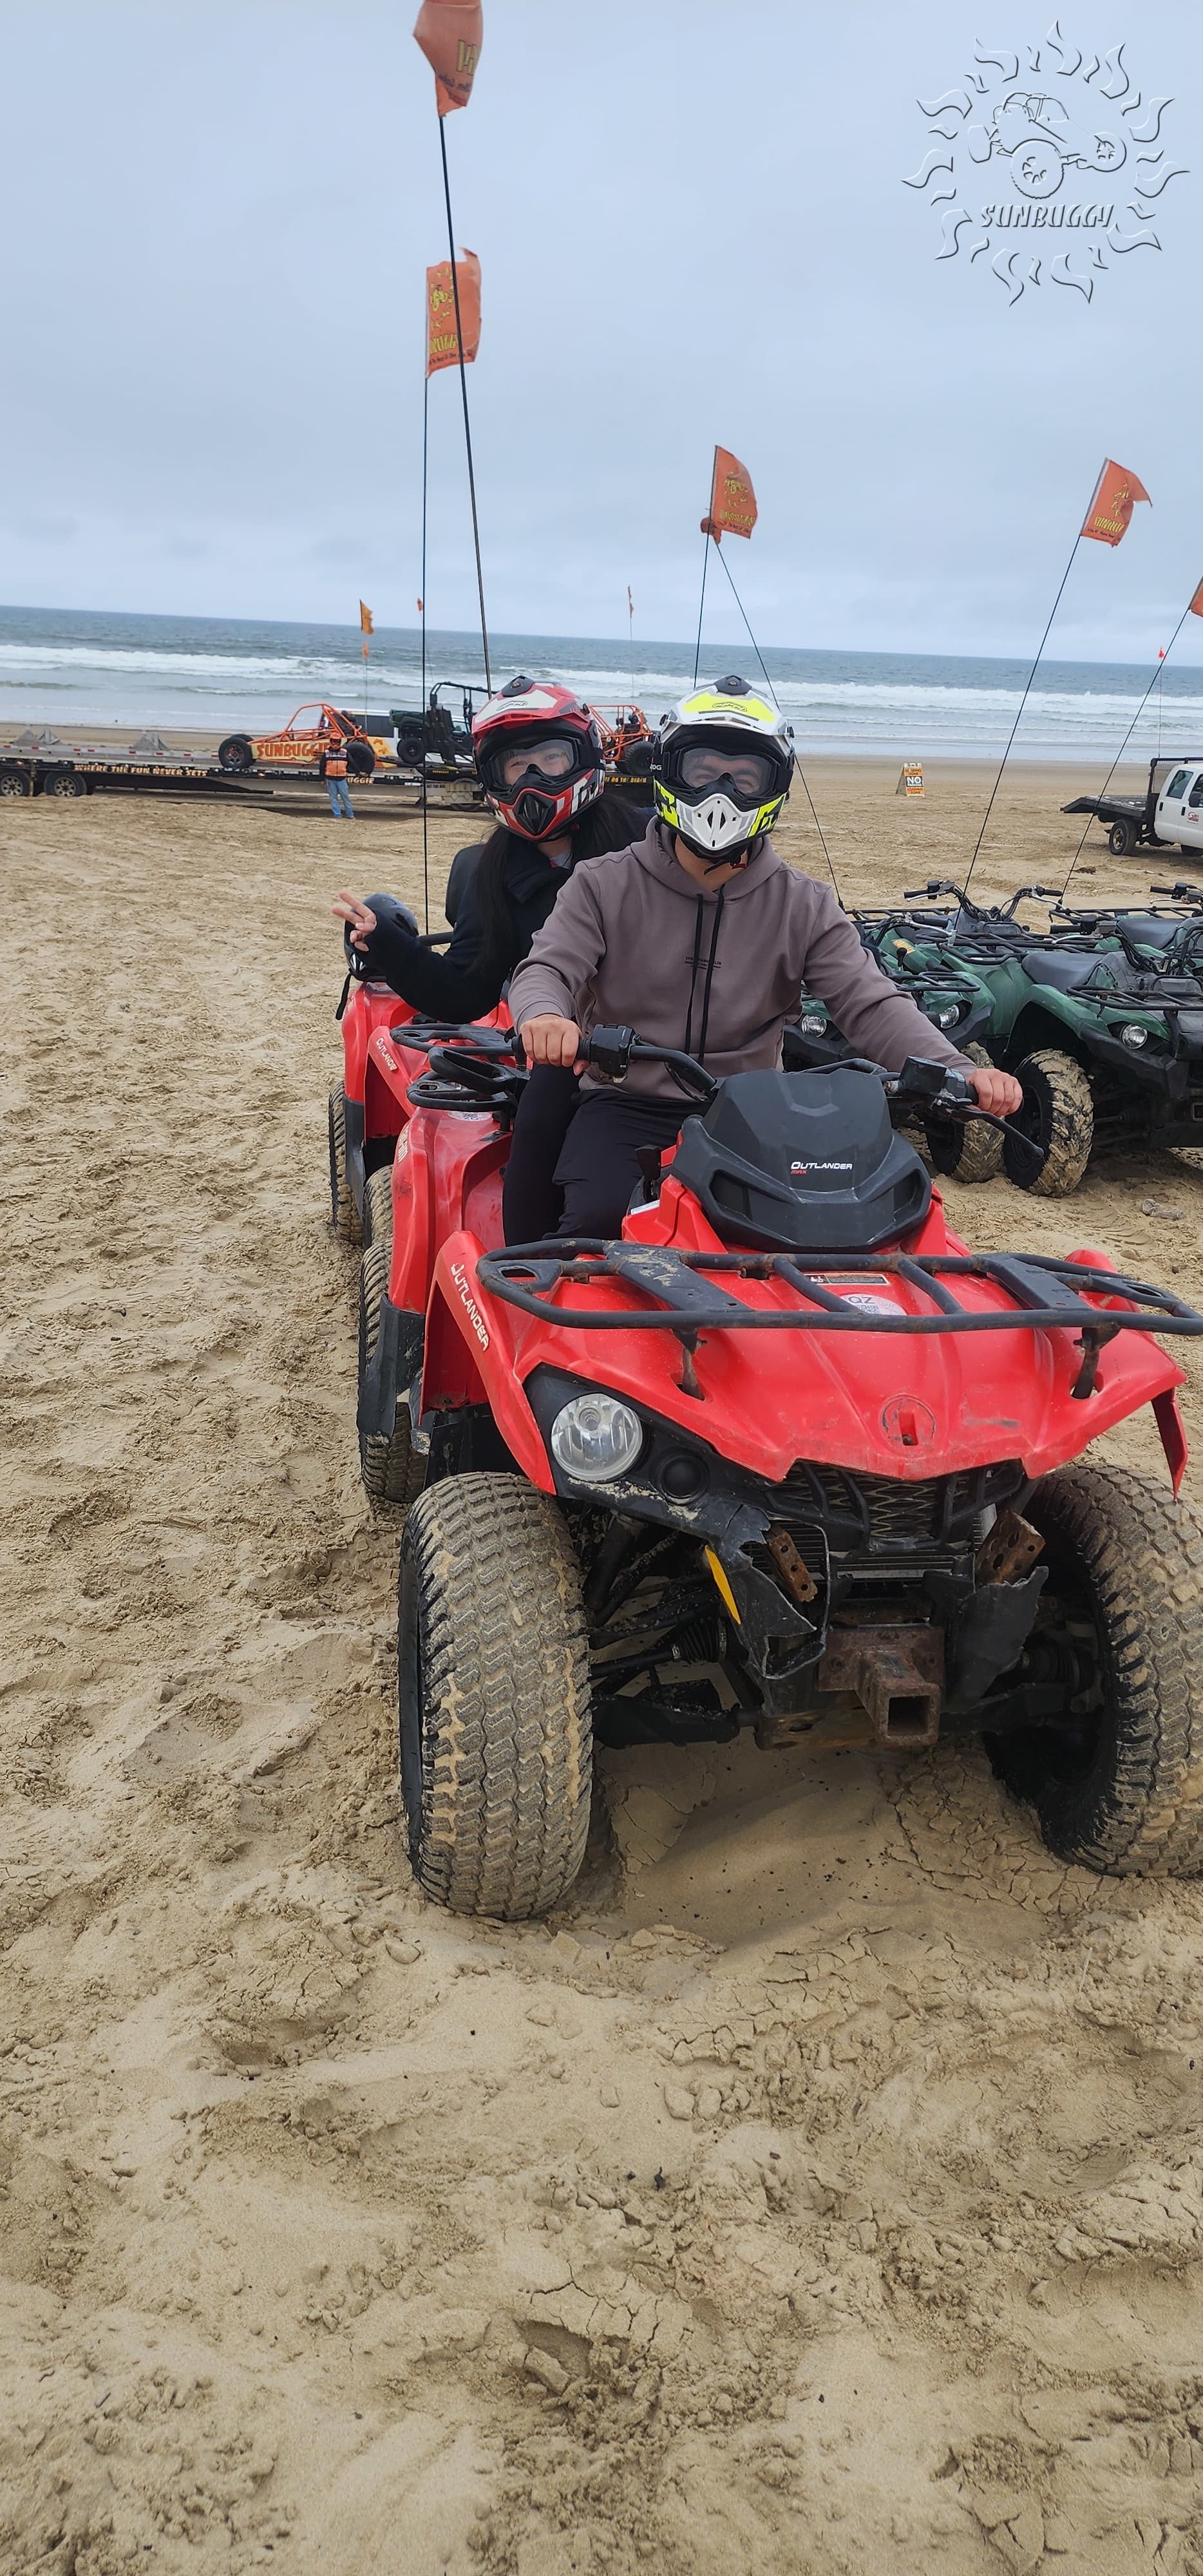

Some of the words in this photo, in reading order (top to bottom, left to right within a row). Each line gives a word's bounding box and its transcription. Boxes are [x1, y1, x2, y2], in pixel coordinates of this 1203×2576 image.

[74, 764, 108, 772] WHERE
[111, 765, 129, 773] THE
[153, 767, 183, 776] NEVER
[185, 768, 208, 777] SETS
[791, 1161, 853, 1170] OUTLANDER
